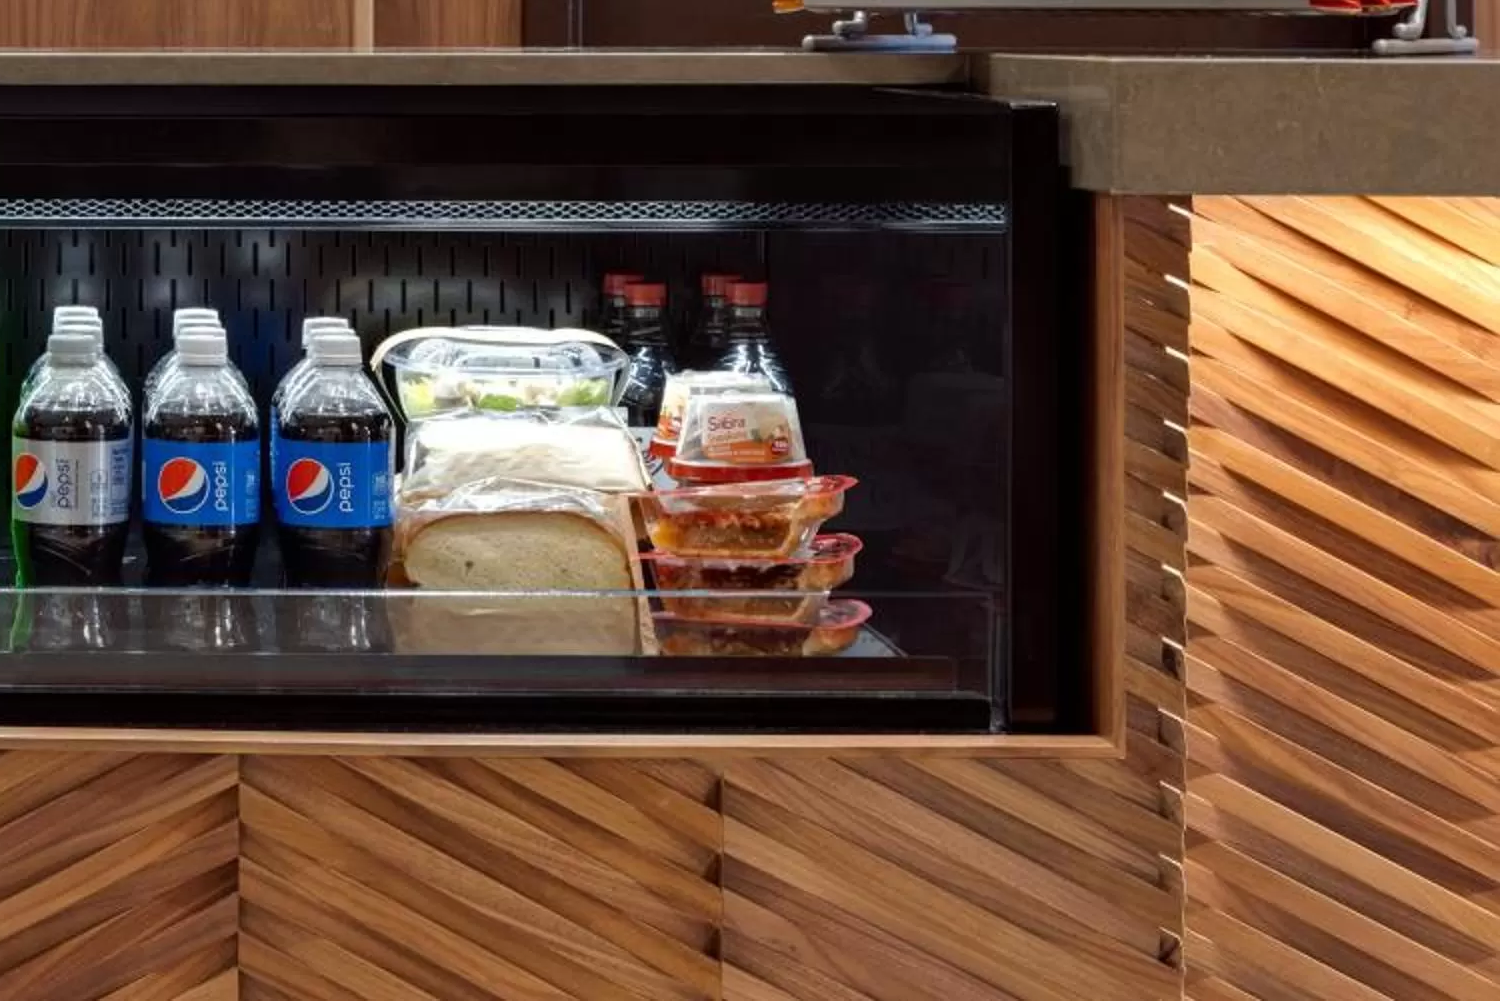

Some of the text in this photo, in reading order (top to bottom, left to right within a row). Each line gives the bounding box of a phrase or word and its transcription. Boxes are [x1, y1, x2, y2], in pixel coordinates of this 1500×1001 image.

[56, 458, 72, 510] pepsi
[212, 461, 229, 513] pepsi
[338, 461, 355, 513] pepsi
